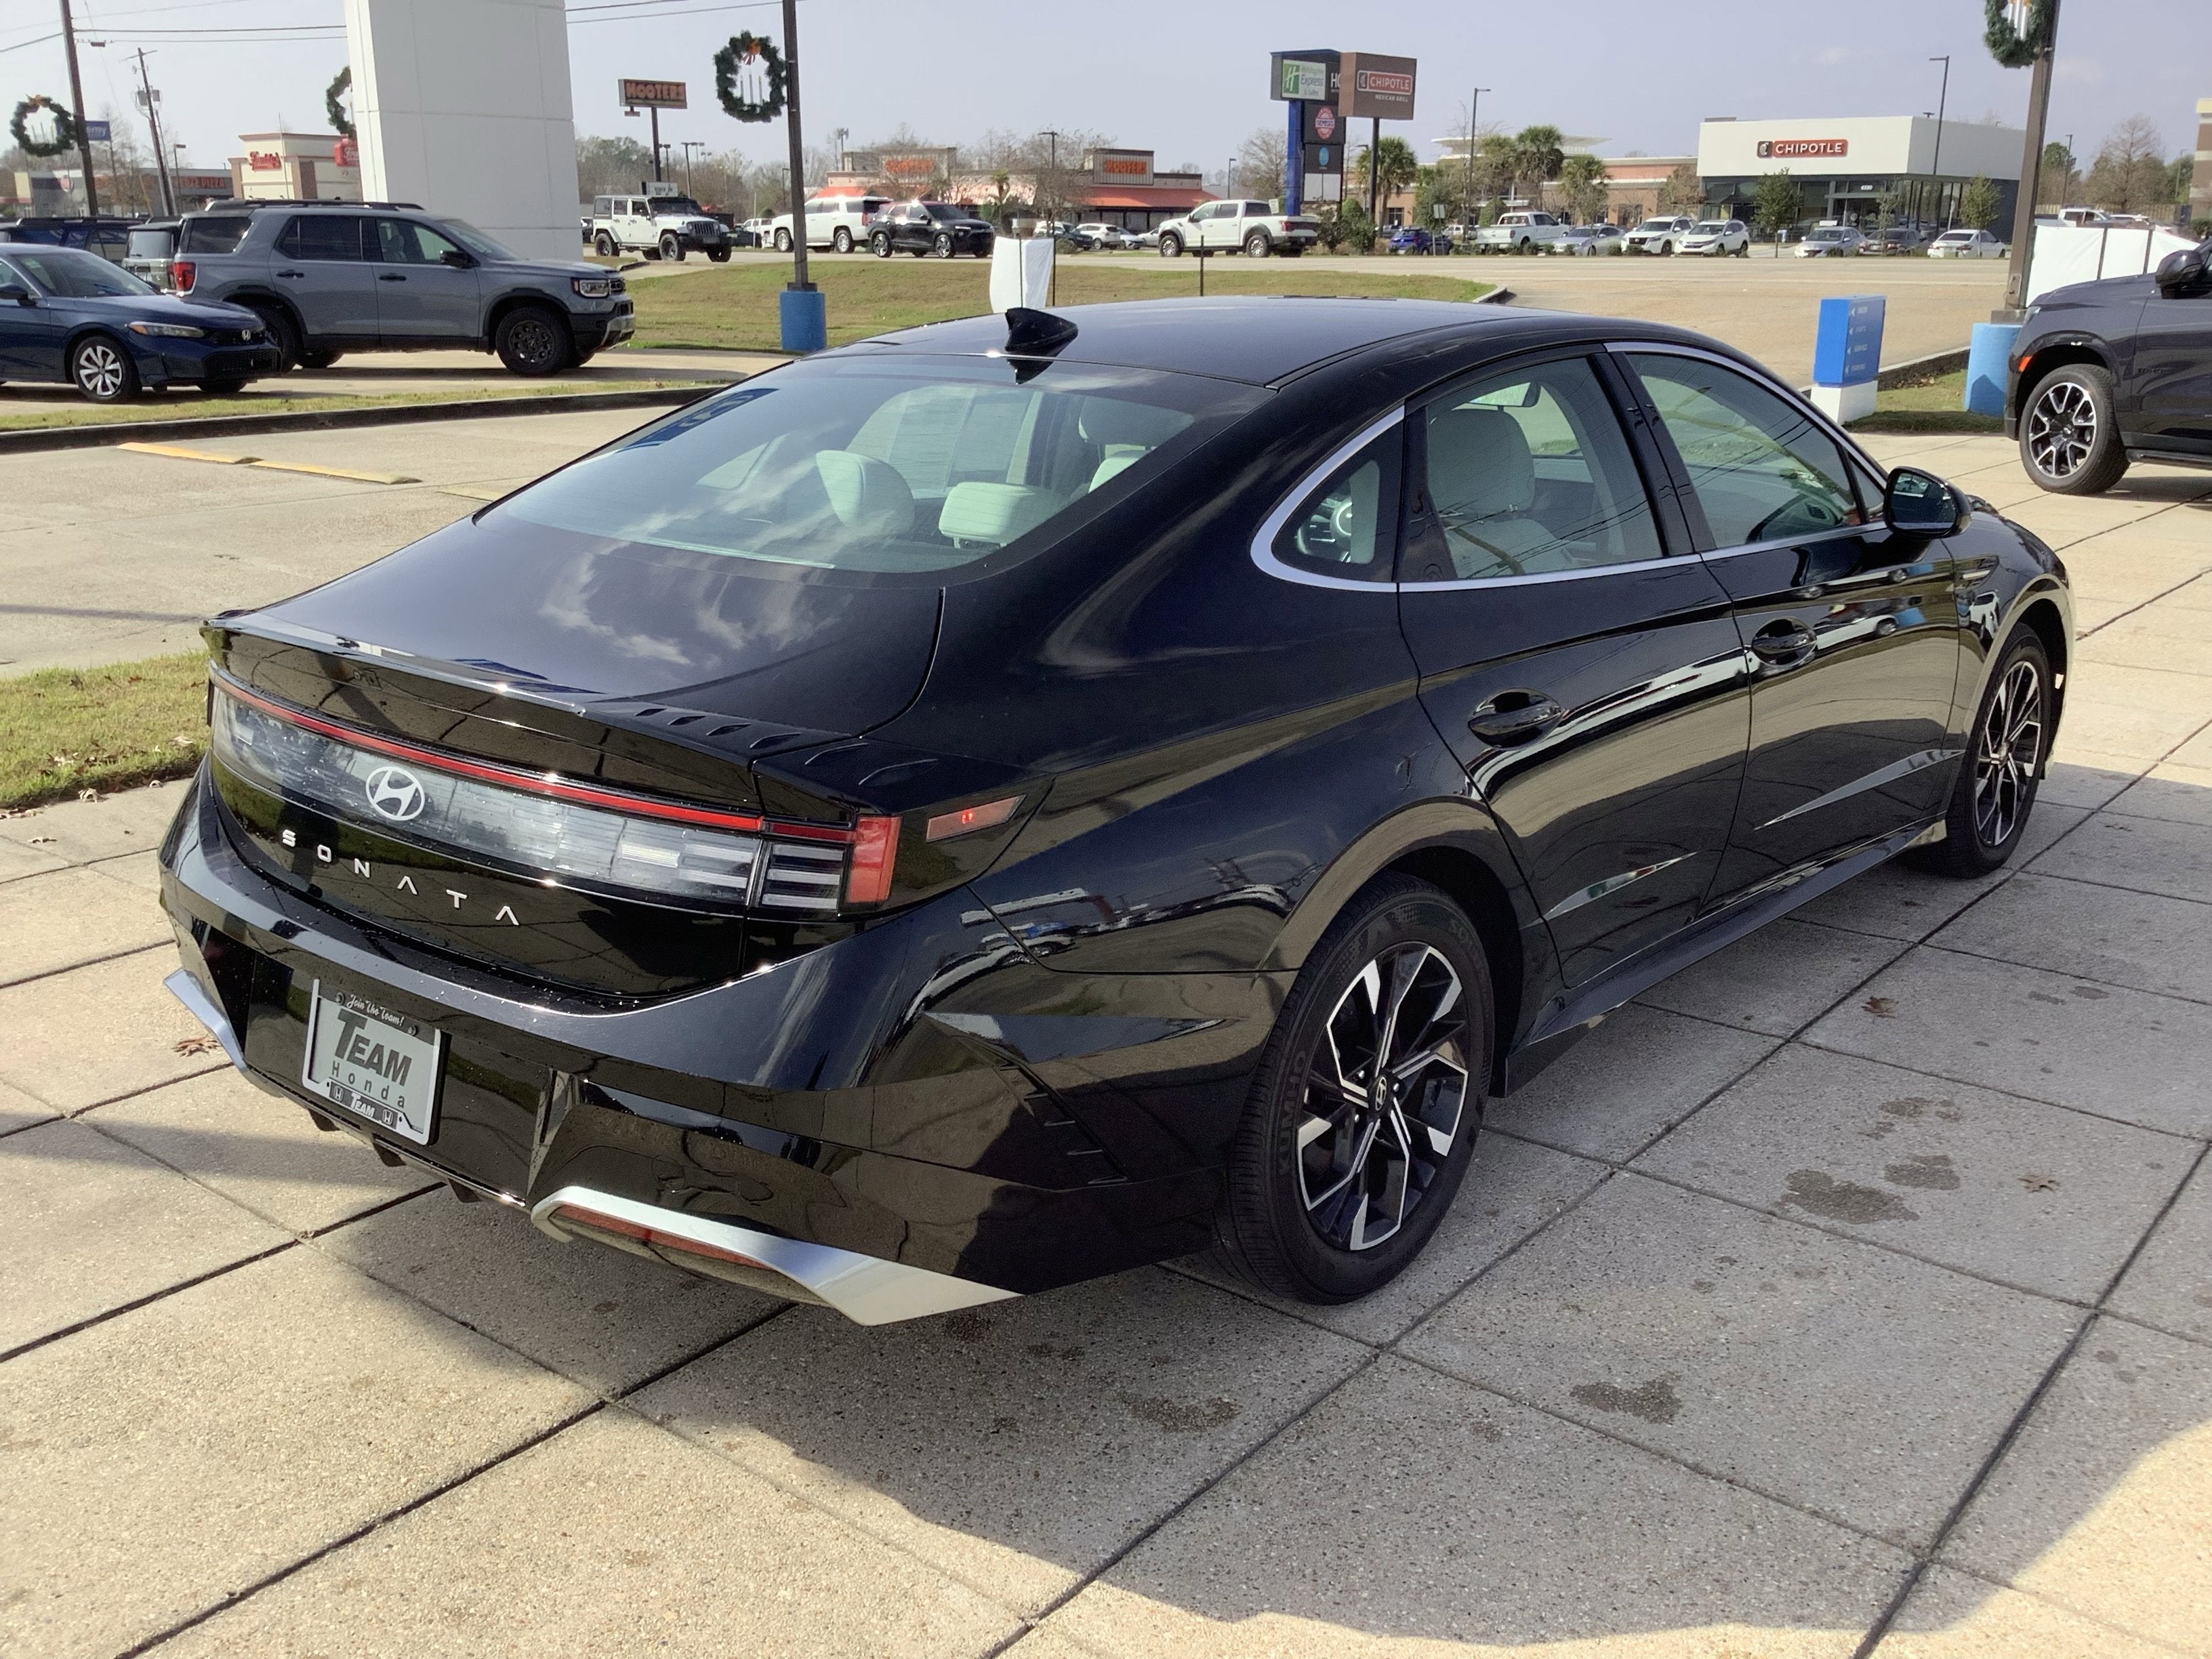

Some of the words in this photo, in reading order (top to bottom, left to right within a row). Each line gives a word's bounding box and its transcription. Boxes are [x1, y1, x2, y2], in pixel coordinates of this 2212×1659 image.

[626, 81, 685, 101] HOOTERS
[1300, 73, 1324, 87] Express
[1370, 77, 1410, 90] CHIPOTLE
[1775, 142, 1843, 154] CHIPOTLE
[282, 829, 519, 926] SONATA
[346, 994, 365, 1010] Join
[334, 1008, 413, 1087] TEAM
[331, 1060, 406, 1109] Honda
[350, 1092, 375, 1118] TEAM
[1279, 1050, 1307, 1175] KUMHO
